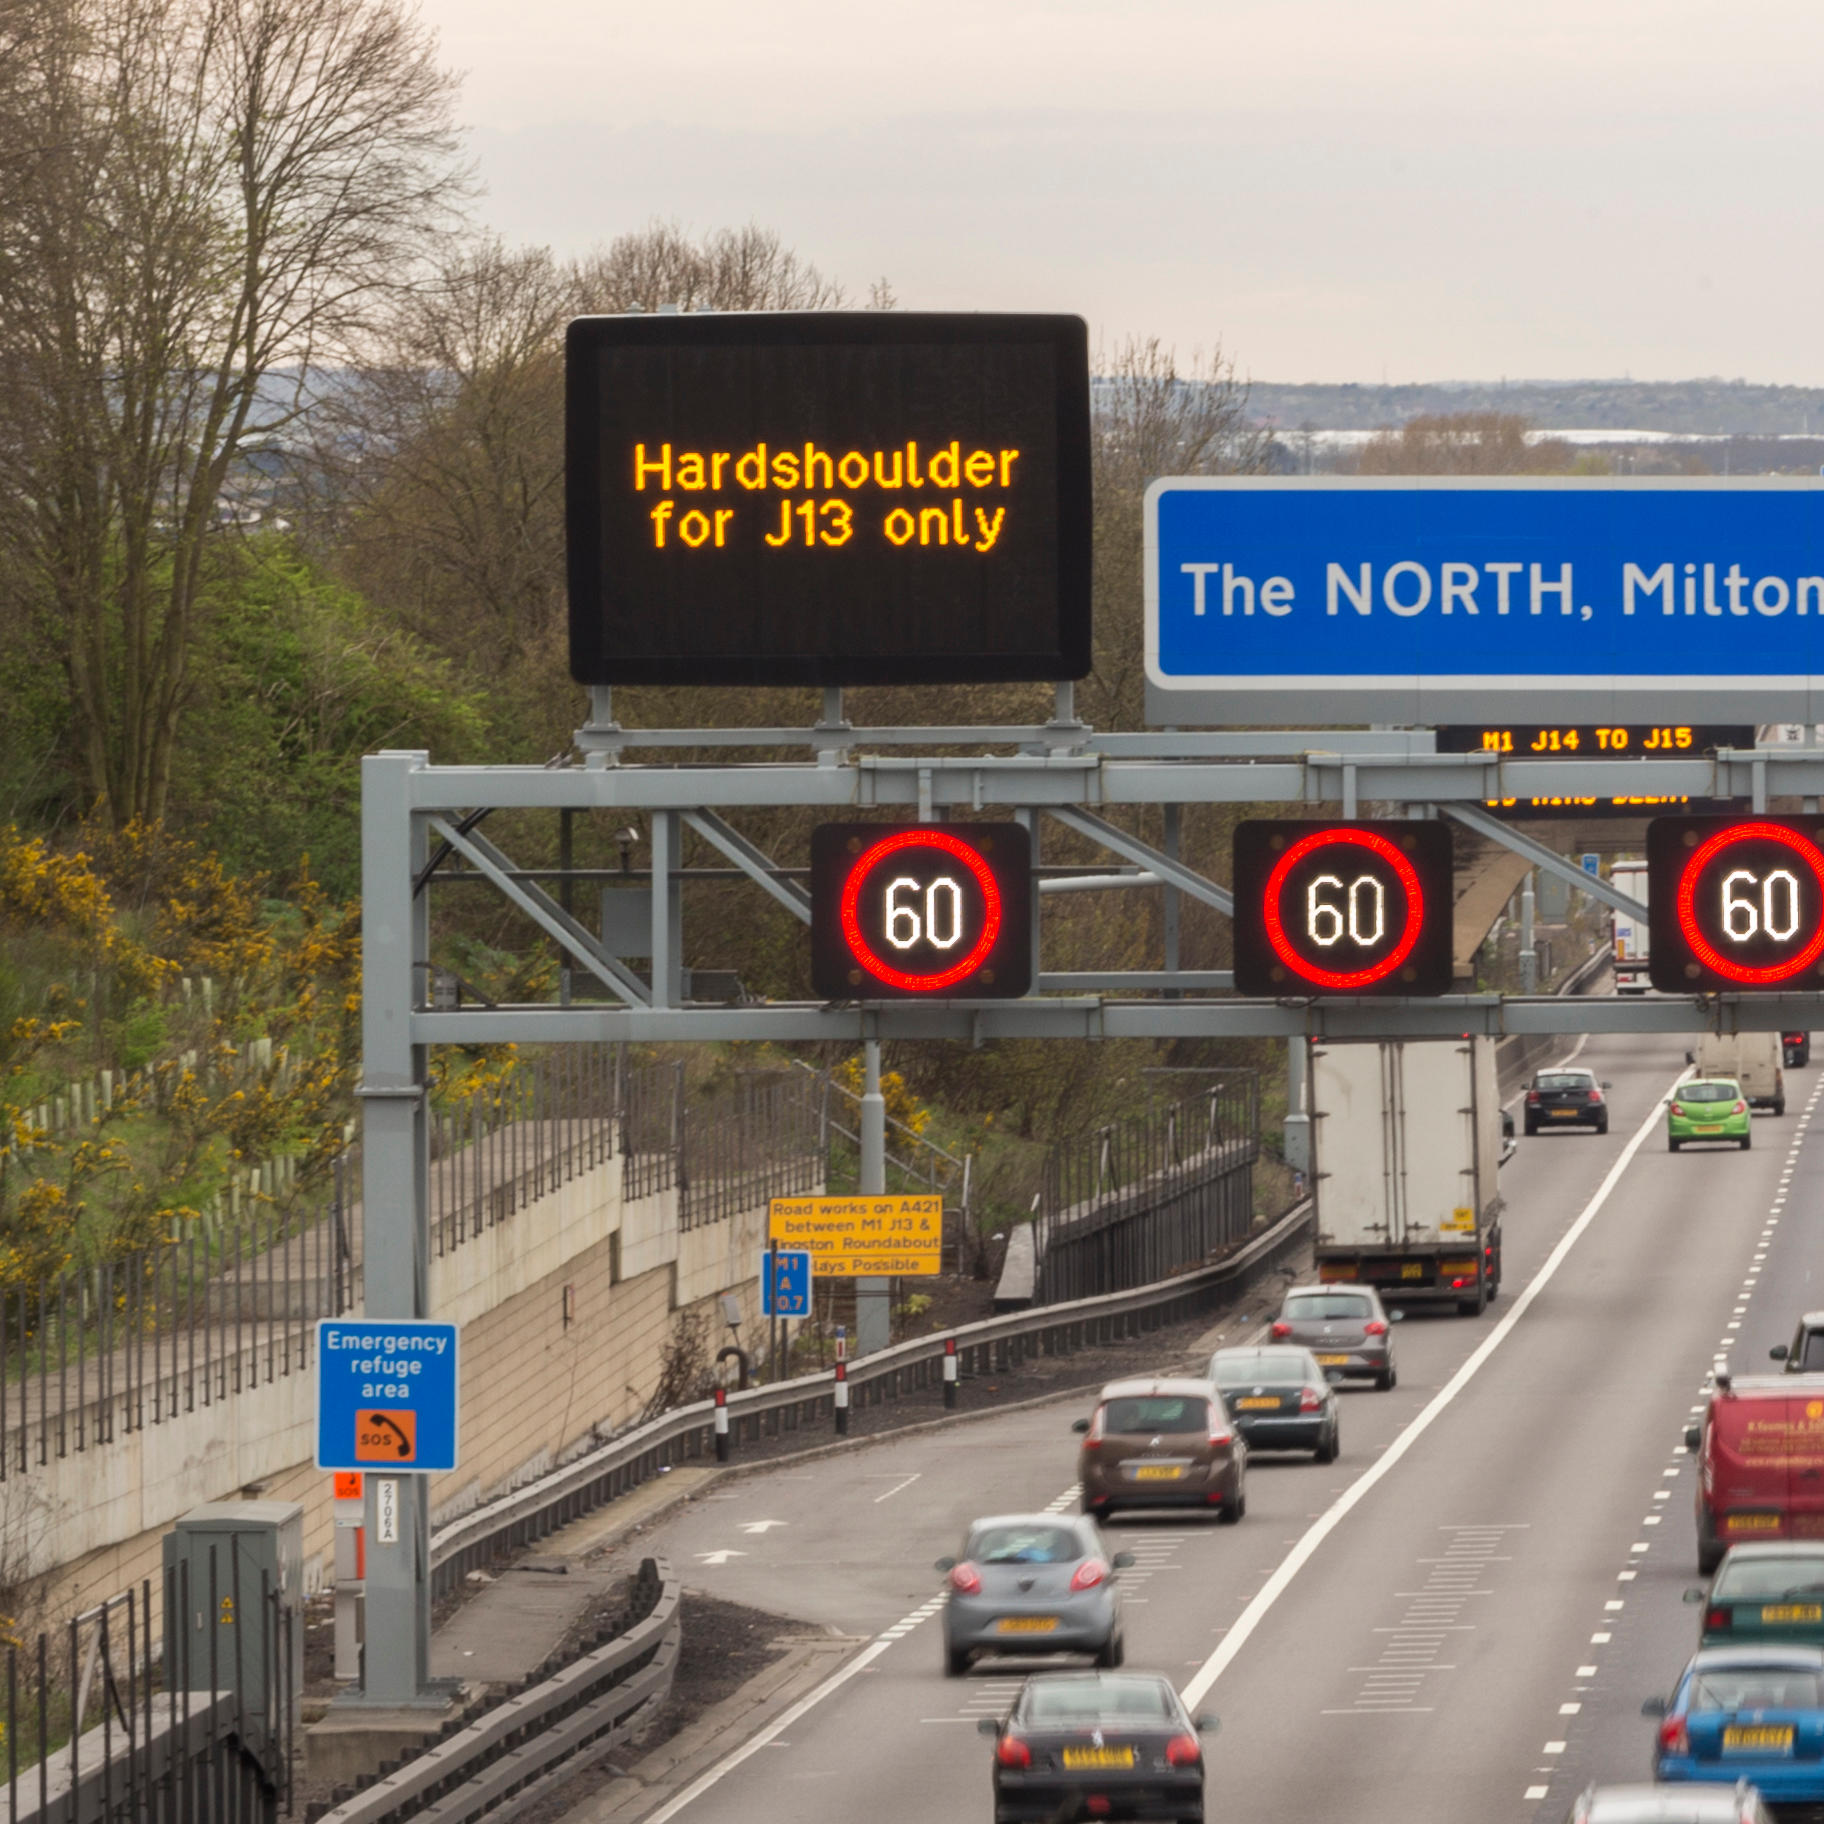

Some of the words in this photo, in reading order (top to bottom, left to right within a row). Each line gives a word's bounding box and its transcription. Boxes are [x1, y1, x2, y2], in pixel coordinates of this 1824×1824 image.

[635, 440, 1020, 491] Hardshoulder
[650, 500, 734, 548] for
[764, 498, 854, 547] J13
[883, 497, 1006, 552] only
[1181, 562, 1295, 616] The
[1326, 561, 1593, 621] NORTH,
[1482, 730, 1514, 752] M1
[1530, 729, 1580, 751] J14
[1595, 728, 1629, 750] TO
[1643, 726, 1693, 749] J15
[885, 876, 963, 949] 60
[1307, 875, 1384, 946] 60
[1720, 870, 1800, 942] 60
[773, 1203, 813, 1216] Road
[819, 1203, 867, 1215] works
[873, 1204, 893, 1214] on
[900, 1201, 940, 1214] A421
[785, 1220, 855, 1233] between
[861, 1219, 882, 1231] M1
[888, 1218, 913, 1231] J13
[919, 1219, 930, 1230] &
[776, 1237, 835, 1250] ingston
[842, 1236, 940, 1249] Roundabout
[812, 1259, 846, 1274] lays
[852, 1258, 919, 1271] Possible
[780, 1276, 791, 1290] A
[327, 1331, 447, 1355] Emergency
[351, 1355, 422, 1378] refuge
[361, 1383, 410, 1398] area
[360, 1433, 392, 1446] SOS
